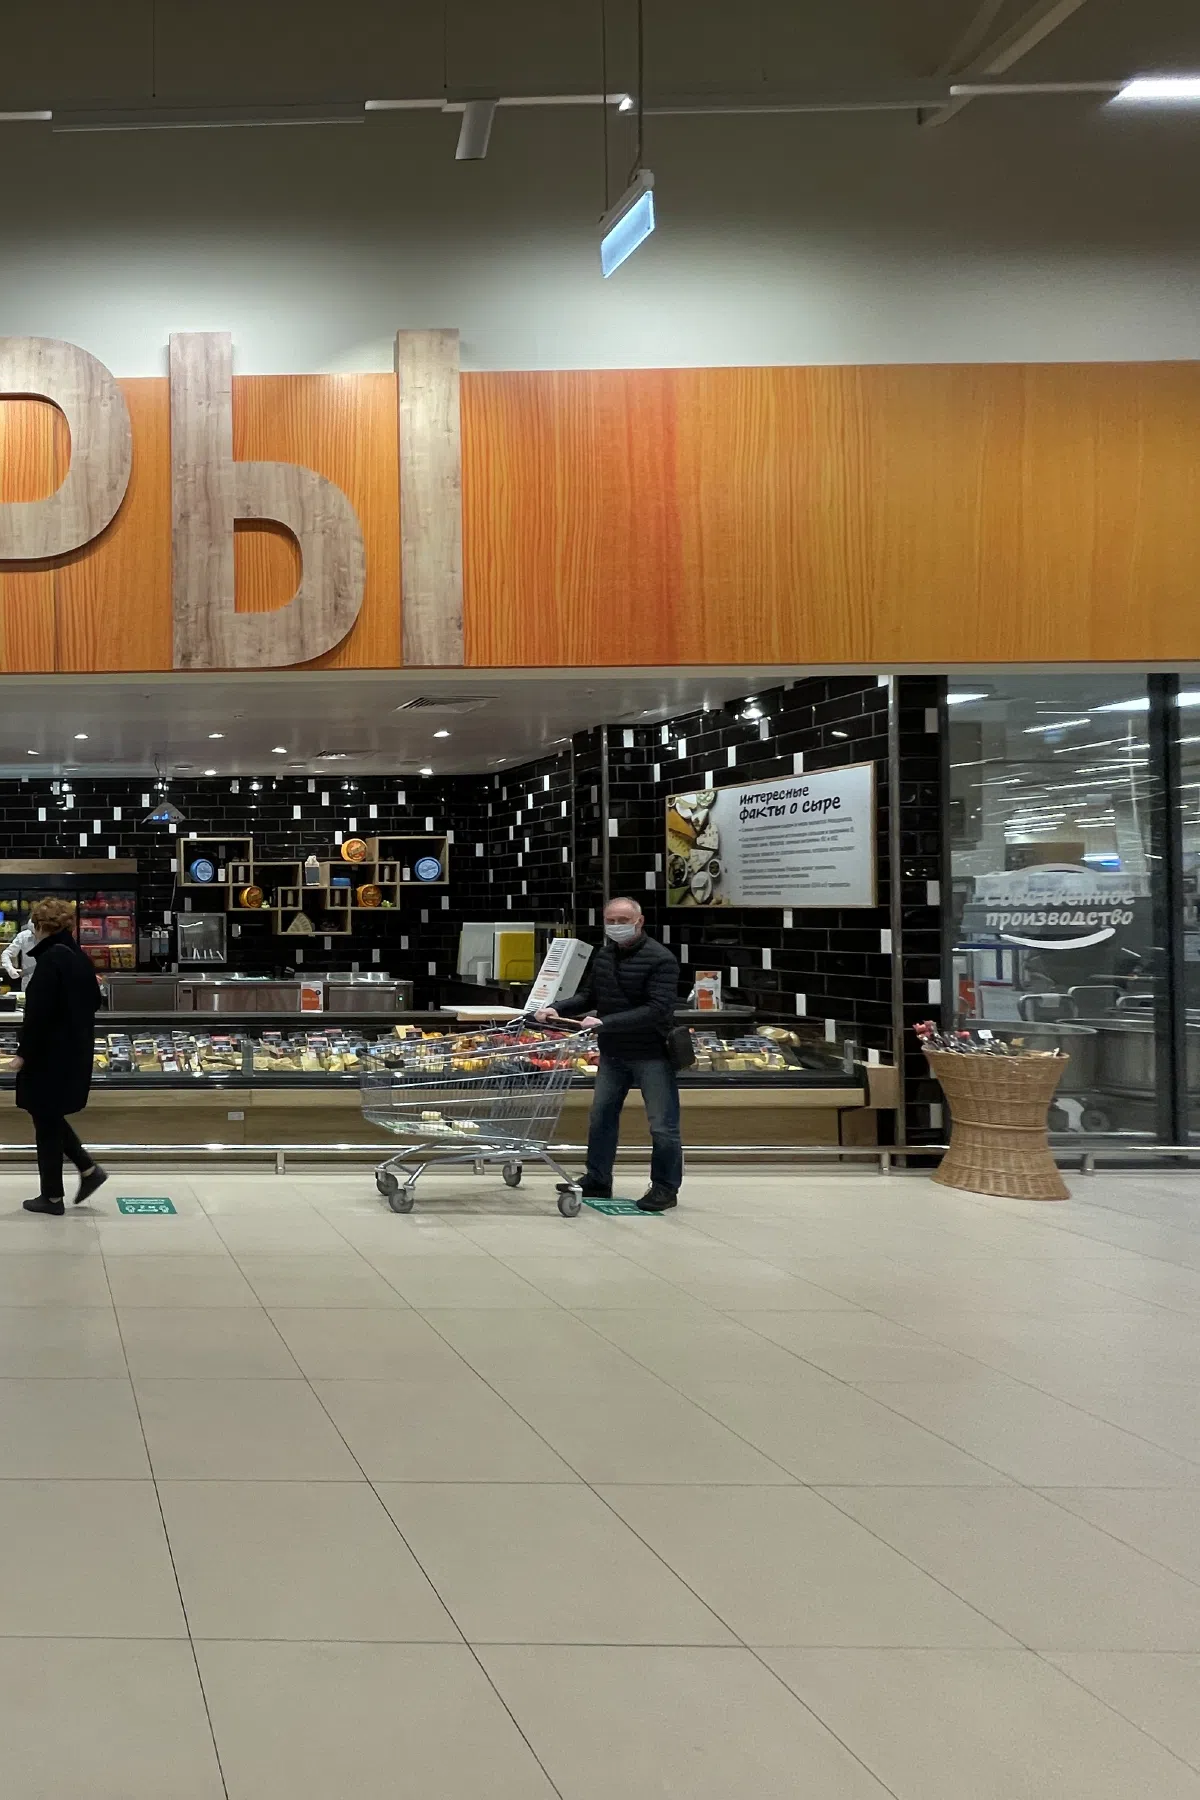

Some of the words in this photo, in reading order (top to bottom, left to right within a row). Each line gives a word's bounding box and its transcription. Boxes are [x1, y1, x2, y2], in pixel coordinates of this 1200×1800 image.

[740, 786, 809, 806] Интересные
[740, 805, 786, 823] факты
[789, 803, 798, 814] о
[802, 796, 841, 814] сыре
[985, 908, 1134, 930] производство
